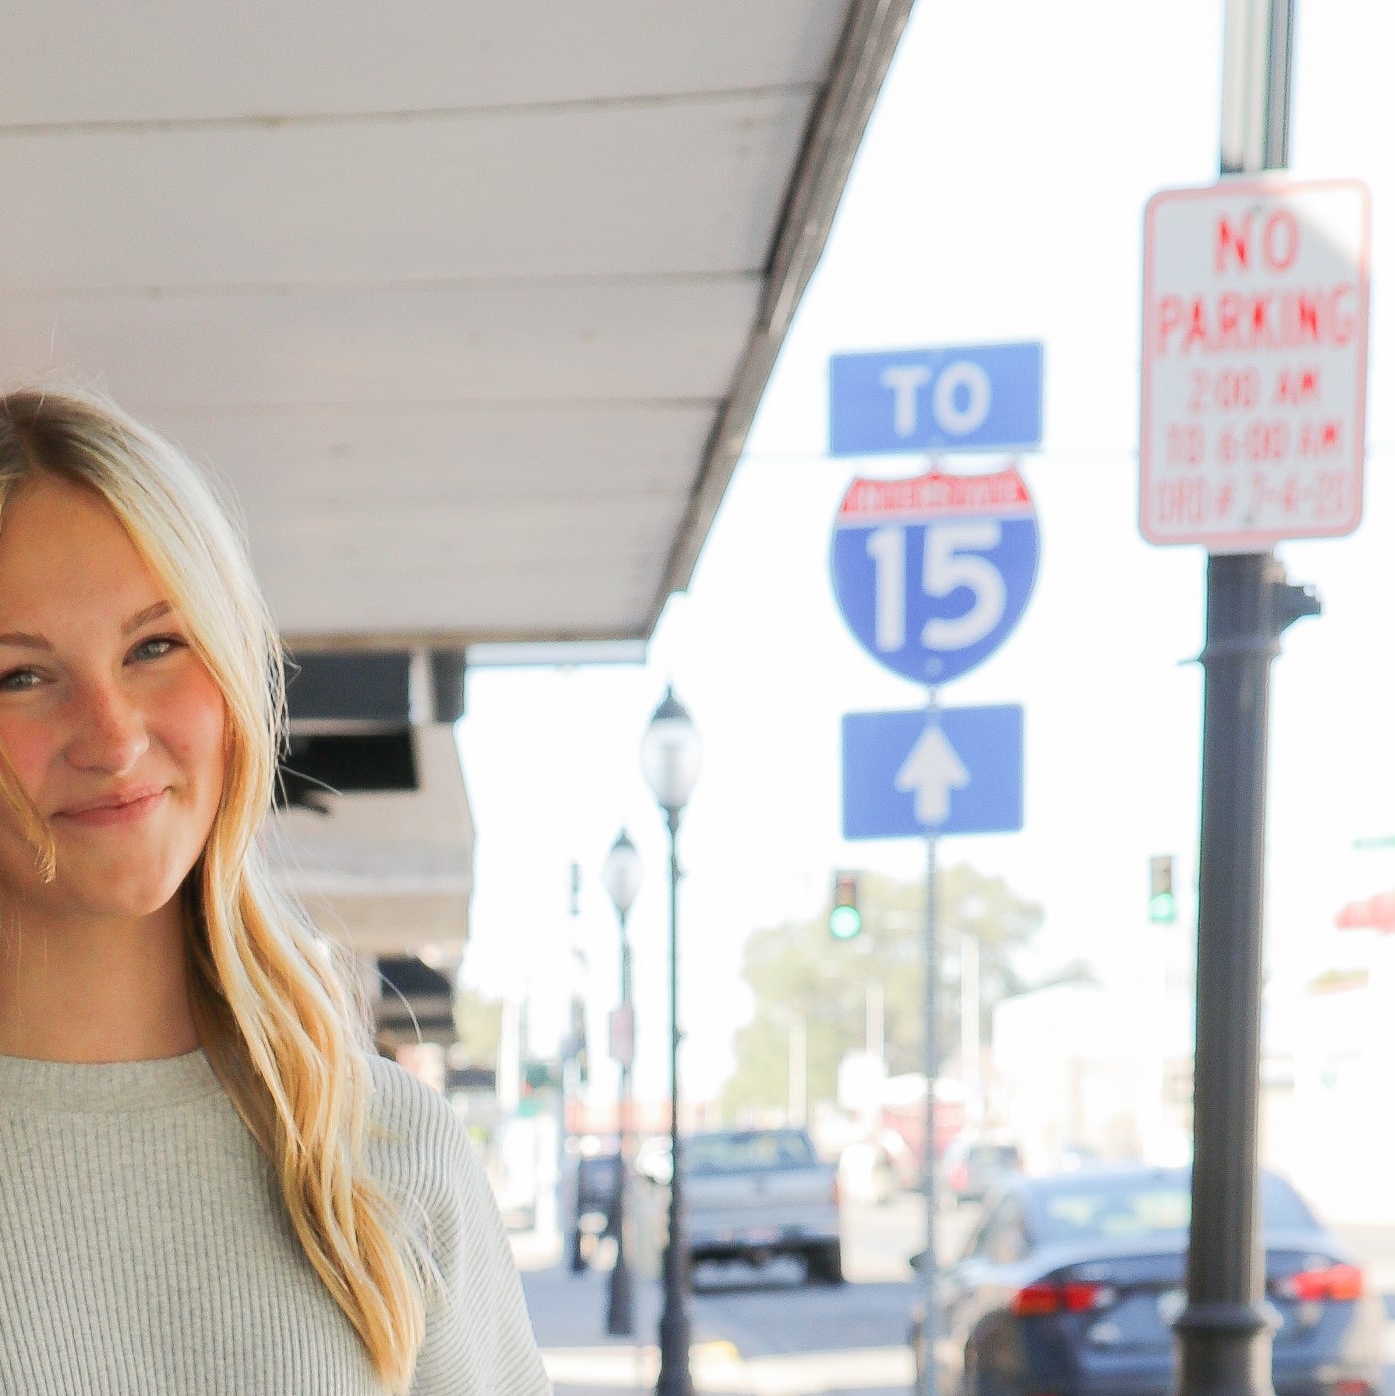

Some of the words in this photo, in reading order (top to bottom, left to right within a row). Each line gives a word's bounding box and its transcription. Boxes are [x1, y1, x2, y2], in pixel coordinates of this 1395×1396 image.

[1214, 207, 1299, 273] NO
[1156, 285, 1355, 354] PARKING
[879, 360, 992, 439] TO
[866, 520, 1006, 654] 15
